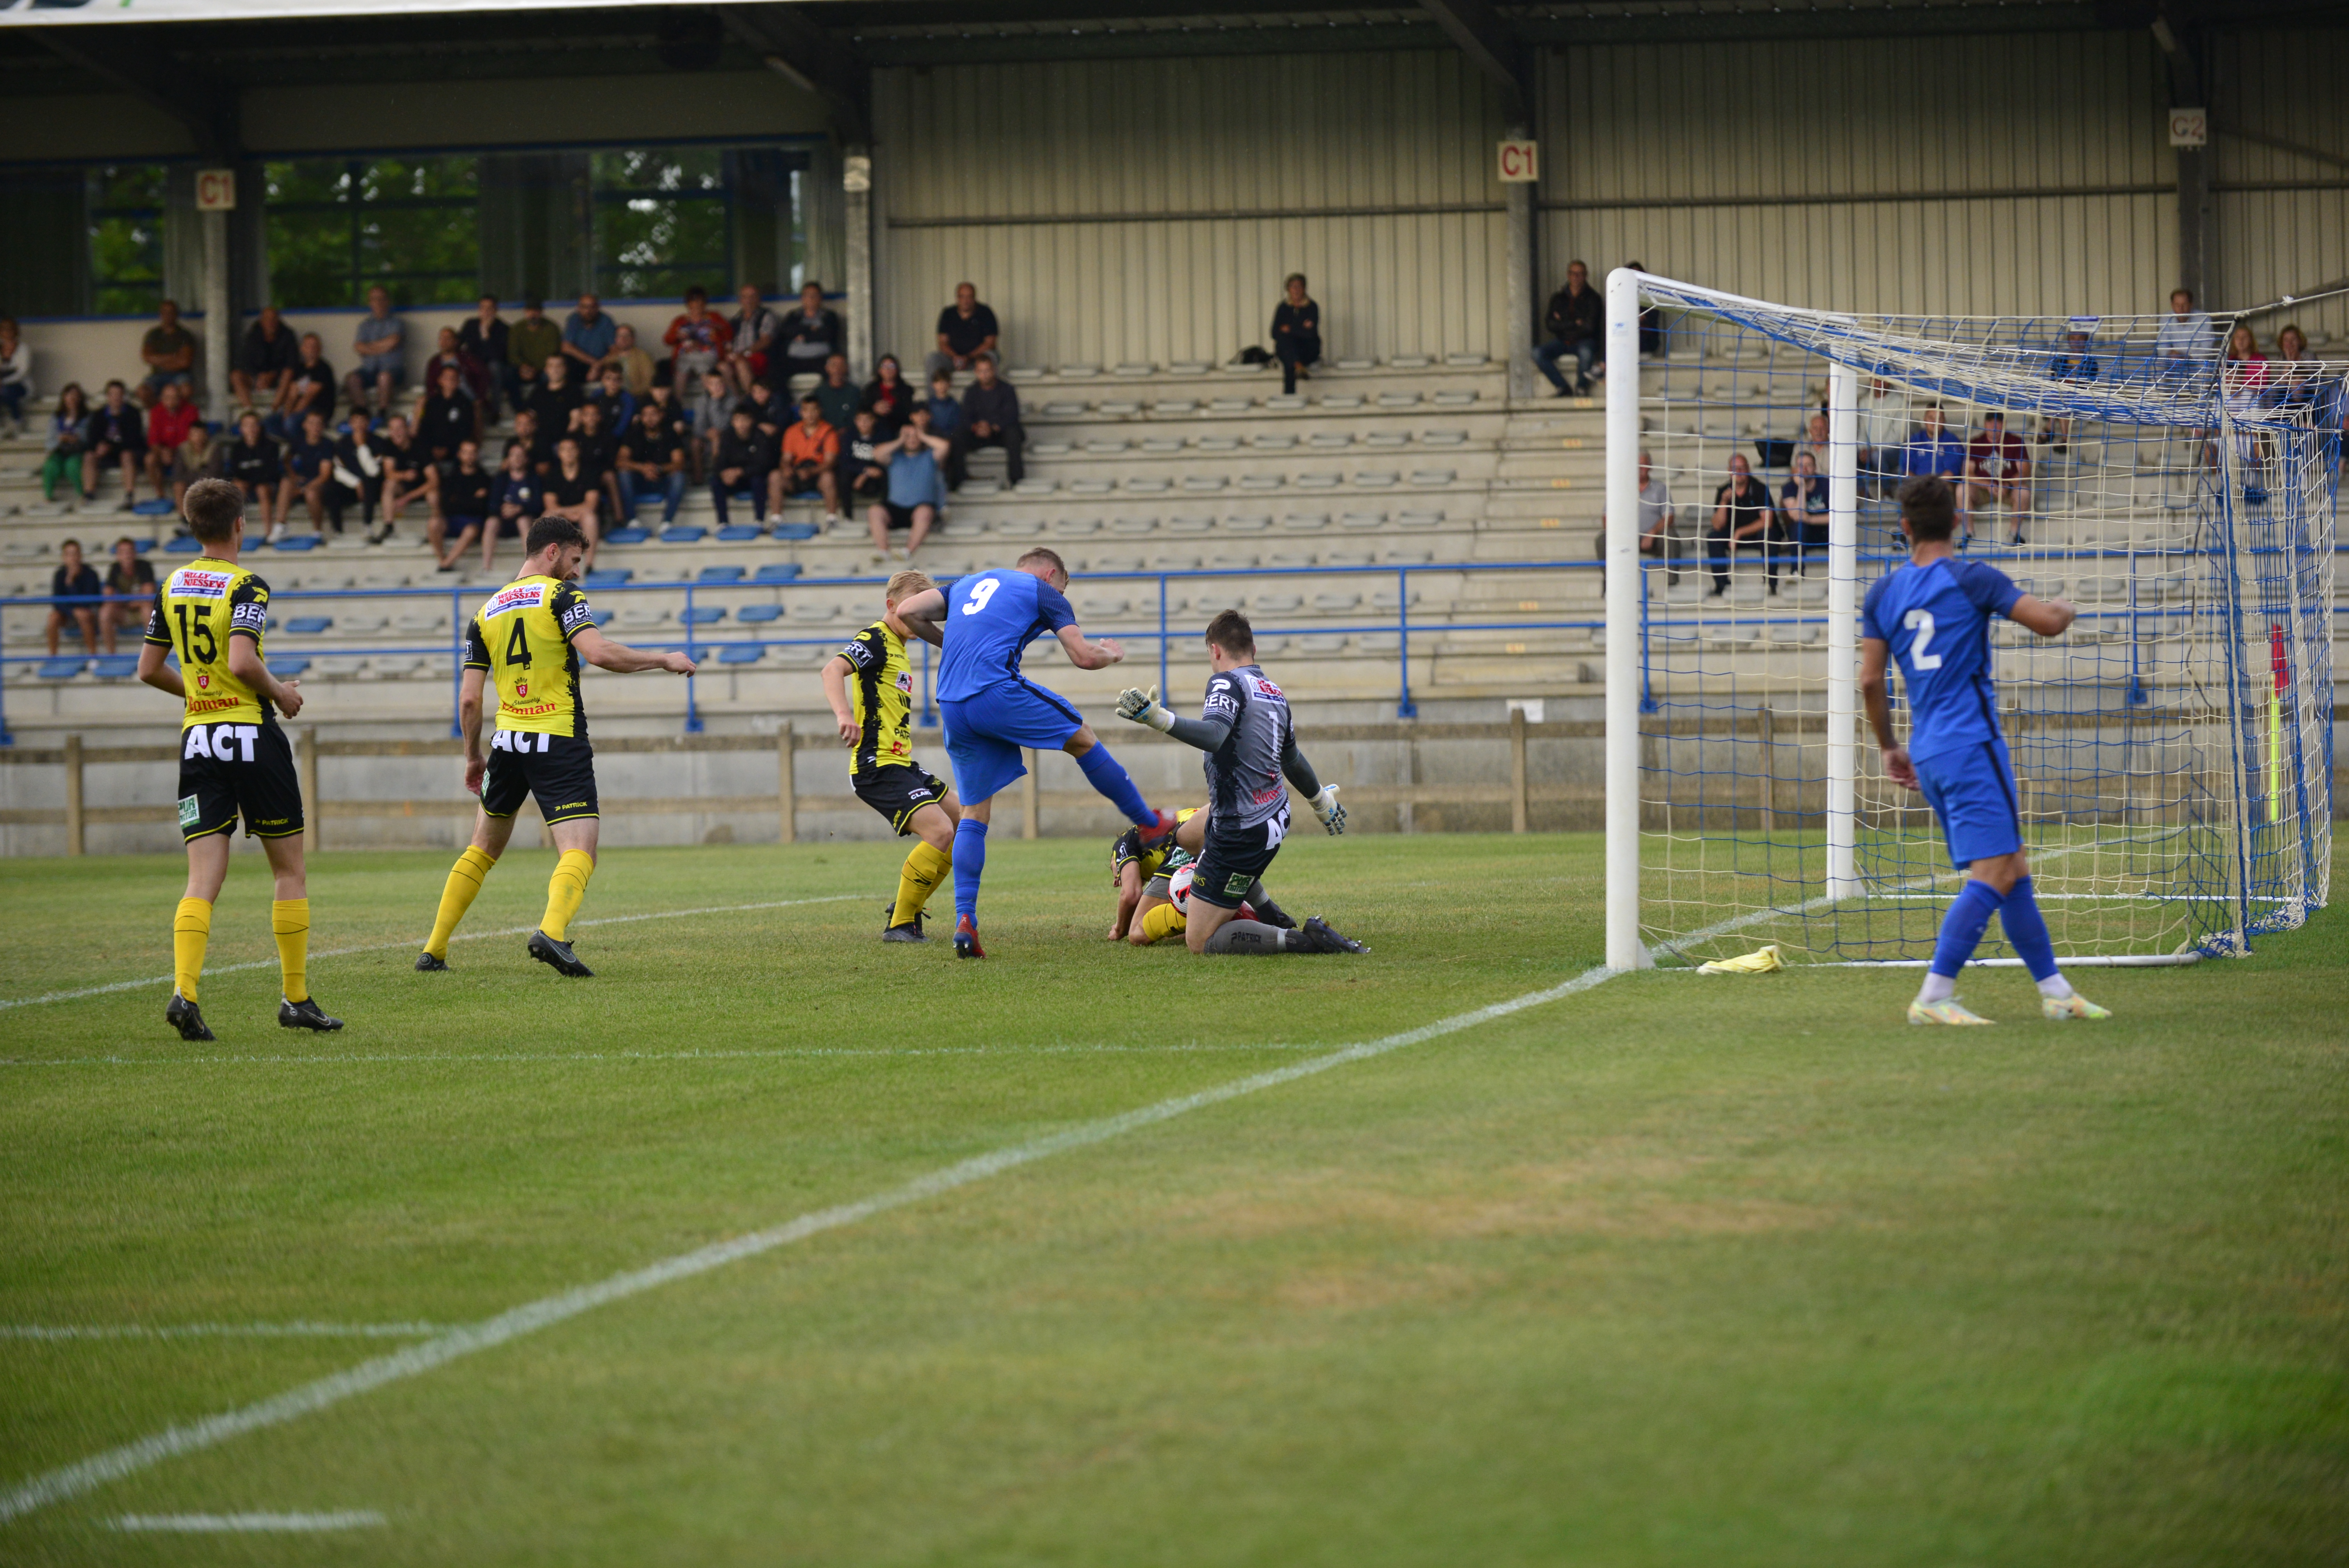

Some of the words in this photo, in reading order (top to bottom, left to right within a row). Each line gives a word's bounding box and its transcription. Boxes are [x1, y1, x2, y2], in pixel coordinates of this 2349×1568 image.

[2172, 117, 2204, 139] C2
[1501, 145, 1534, 176] C1
[200, 174, 231, 205] C1
[184, 579, 226, 588] NAESSENS
[498, 587, 525, 599] WILLY
[498, 591, 540, 605] NAESSENS
[961, 578, 1000, 615] 9
[174, 604, 217, 664] 15
[506, 618, 532, 670] 4
[1903, 609, 1942, 670] 2
[200, 677, 207, 686] R
[519, 686, 526, 694] R
[184, 725, 258, 761] ACT
[1268, 711, 1278, 760] 1
[1227, 884, 1248, 893] NATUR
[1230, 875, 1252, 887] PUR
[1238, 932, 1261, 944] PATRICK
